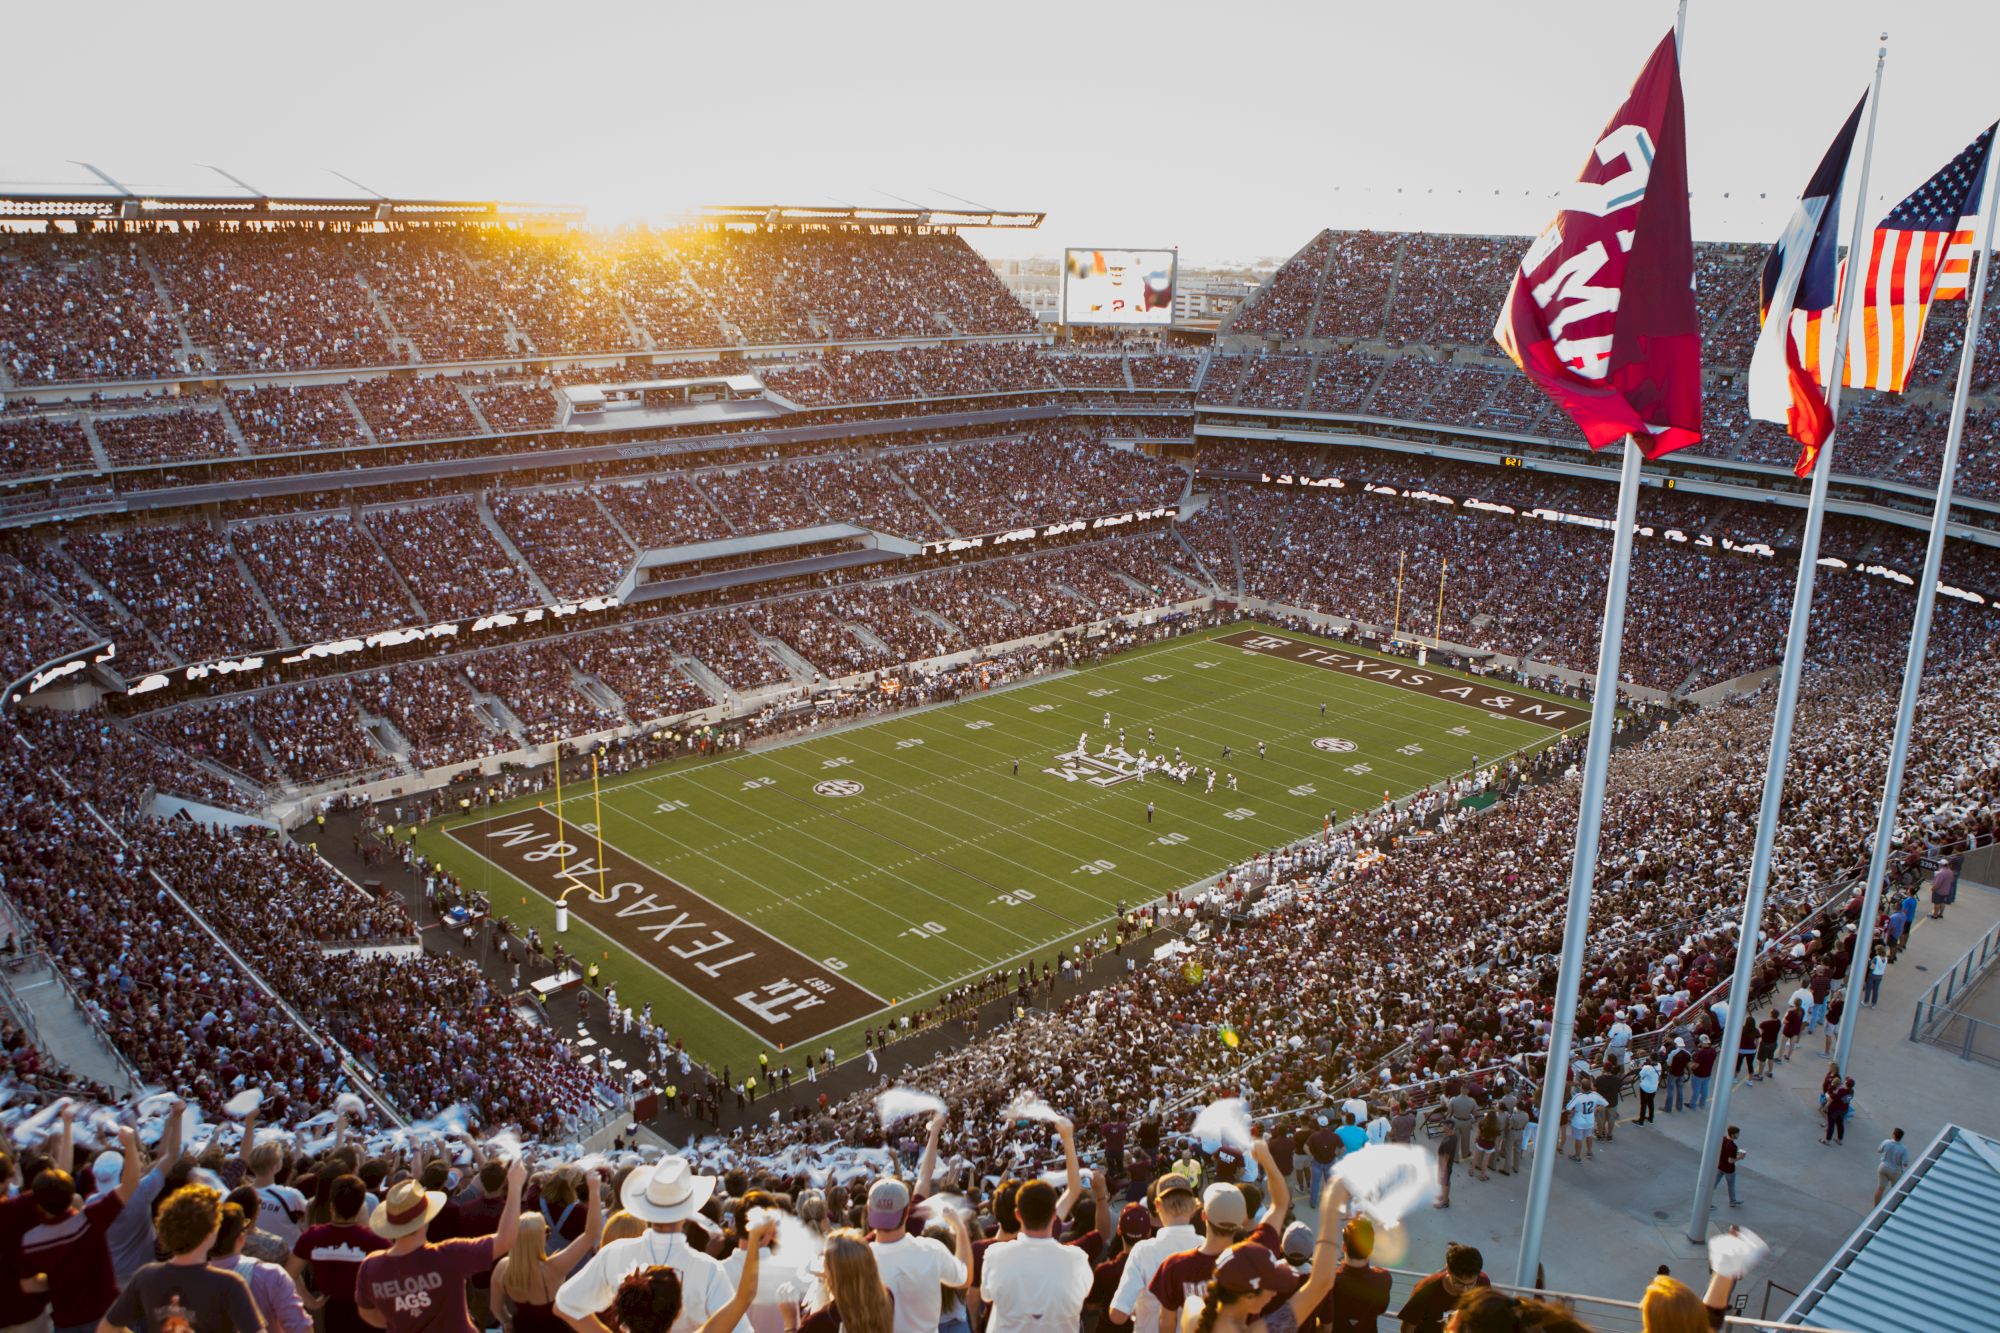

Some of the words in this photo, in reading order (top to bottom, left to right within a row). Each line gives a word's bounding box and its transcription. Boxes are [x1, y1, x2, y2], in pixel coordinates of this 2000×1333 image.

[1298, 648, 1433, 686] TEXAS
[964, 720, 995, 730] 50
[1396, 744, 1424, 756] 20
[823, 757, 855, 768] 30
[1343, 763, 1373, 776] 30
[743, 776, 776, 789] 20
[1287, 784, 1317, 796] 40
[656, 800, 690, 813] 10
[1222, 807, 1257, 821] 50
[1157, 831, 1190, 847] 40
[1080, 859, 1117, 875] 30
[997, 888, 1036, 906] 20
[588, 881, 757, 978] TEXAS
[908, 921, 947, 939] 10
[822, 957, 849, 971] G
[803, 977, 836, 994] 1967
[1582, 1101, 1594, 1115] 12
[372, 1271, 443, 1299] RELOAD
[394, 1291, 432, 1313] AGS
